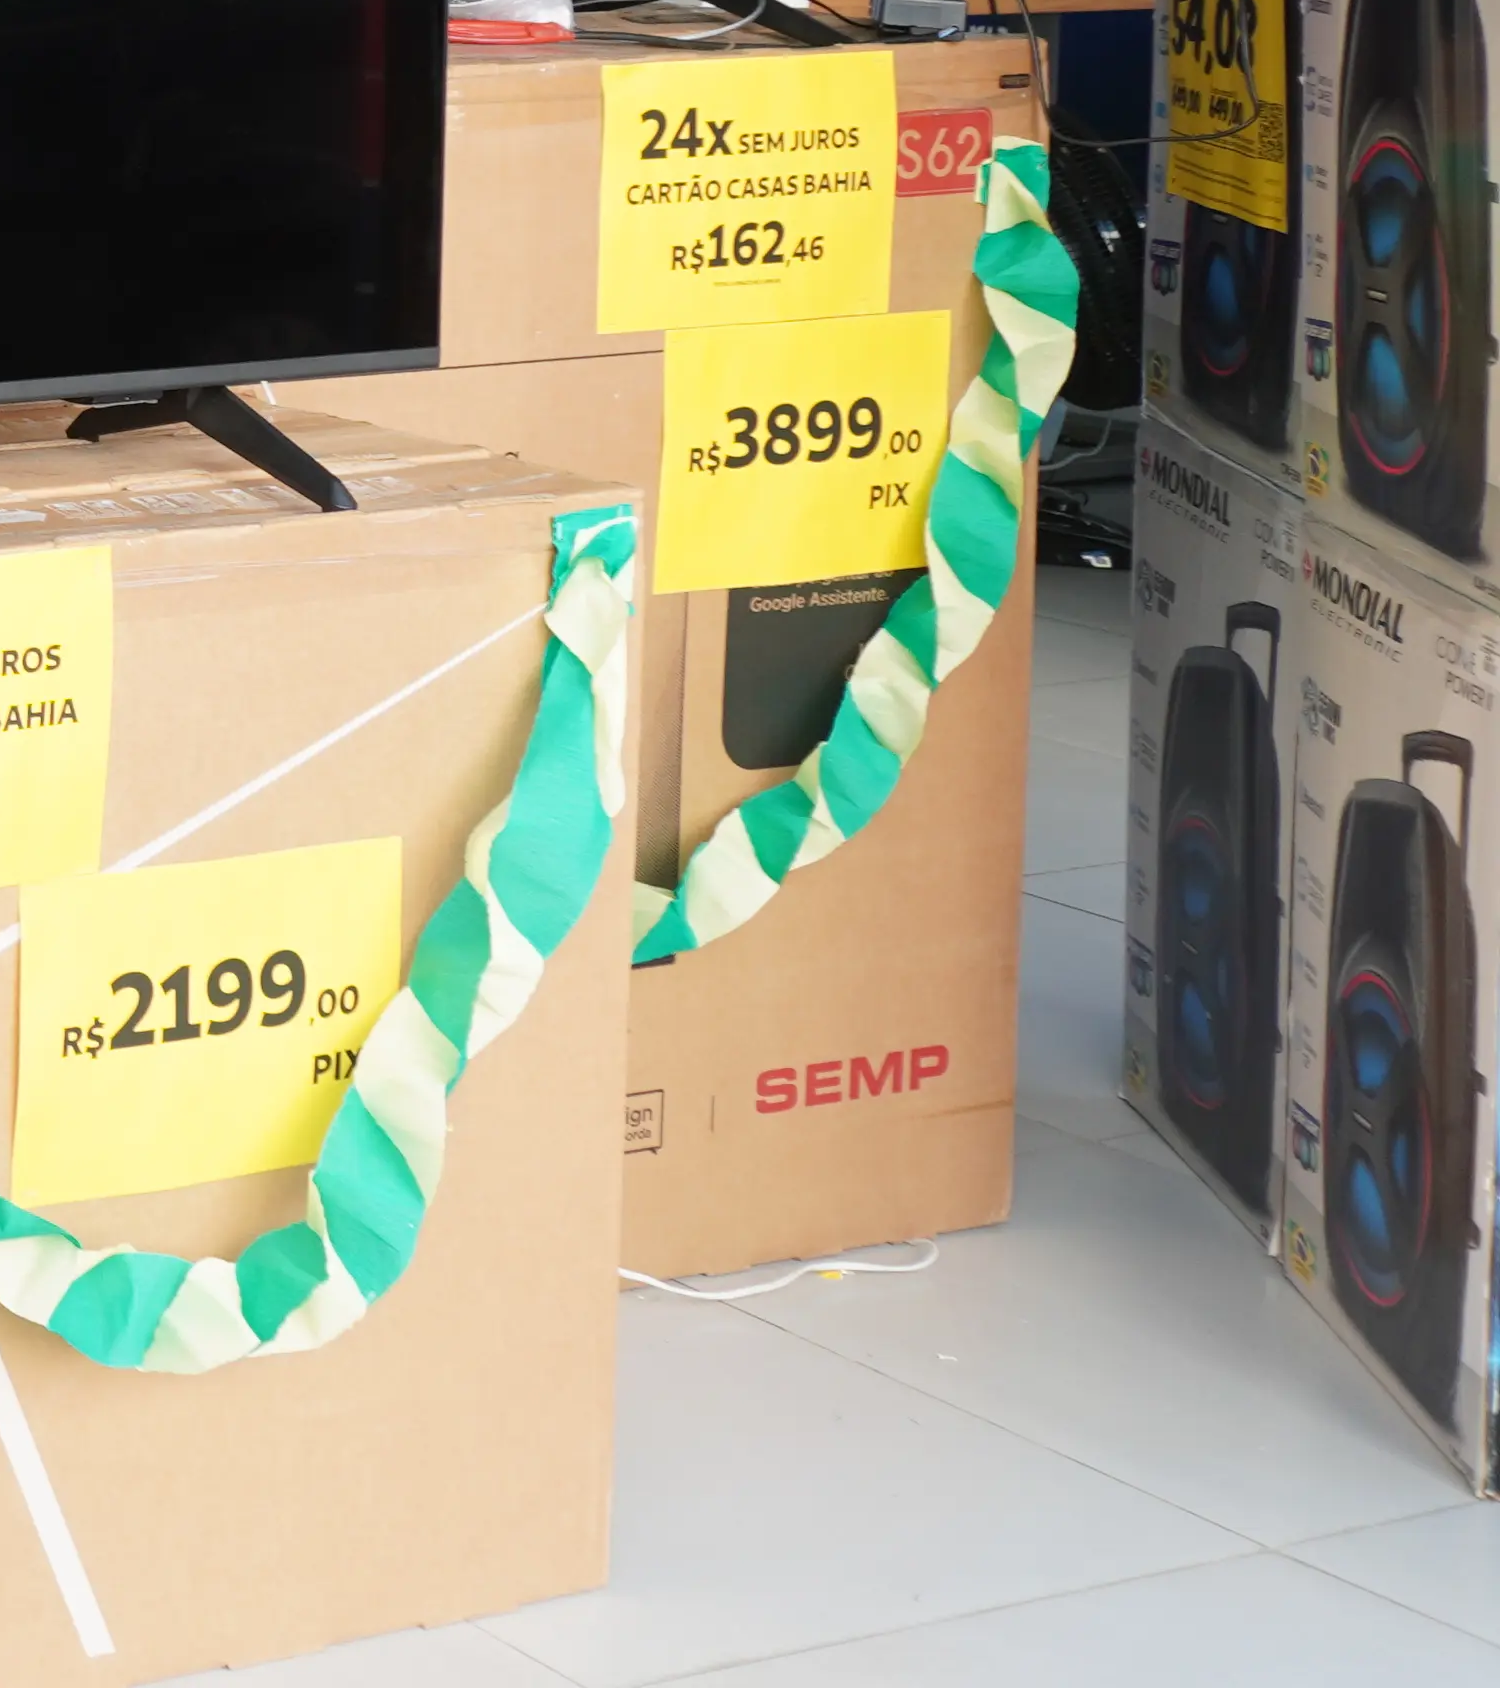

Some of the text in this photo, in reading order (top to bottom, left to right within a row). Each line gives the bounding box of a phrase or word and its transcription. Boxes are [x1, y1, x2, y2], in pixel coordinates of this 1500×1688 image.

[639, 107, 860, 160] 24x SEM JUROS
[896, 128, 981, 179] S62
[626, 170, 872, 205] CARTÃO CASAS BAHIA
[869, 482, 910, 509] PIX
[1150, 456, 1231, 526] MONDIAL
[749, 585, 889, 613] Google Assistente.
[1311, 557, 1404, 644] MONDIAL
[755, 1044, 949, 1114] SEMP
